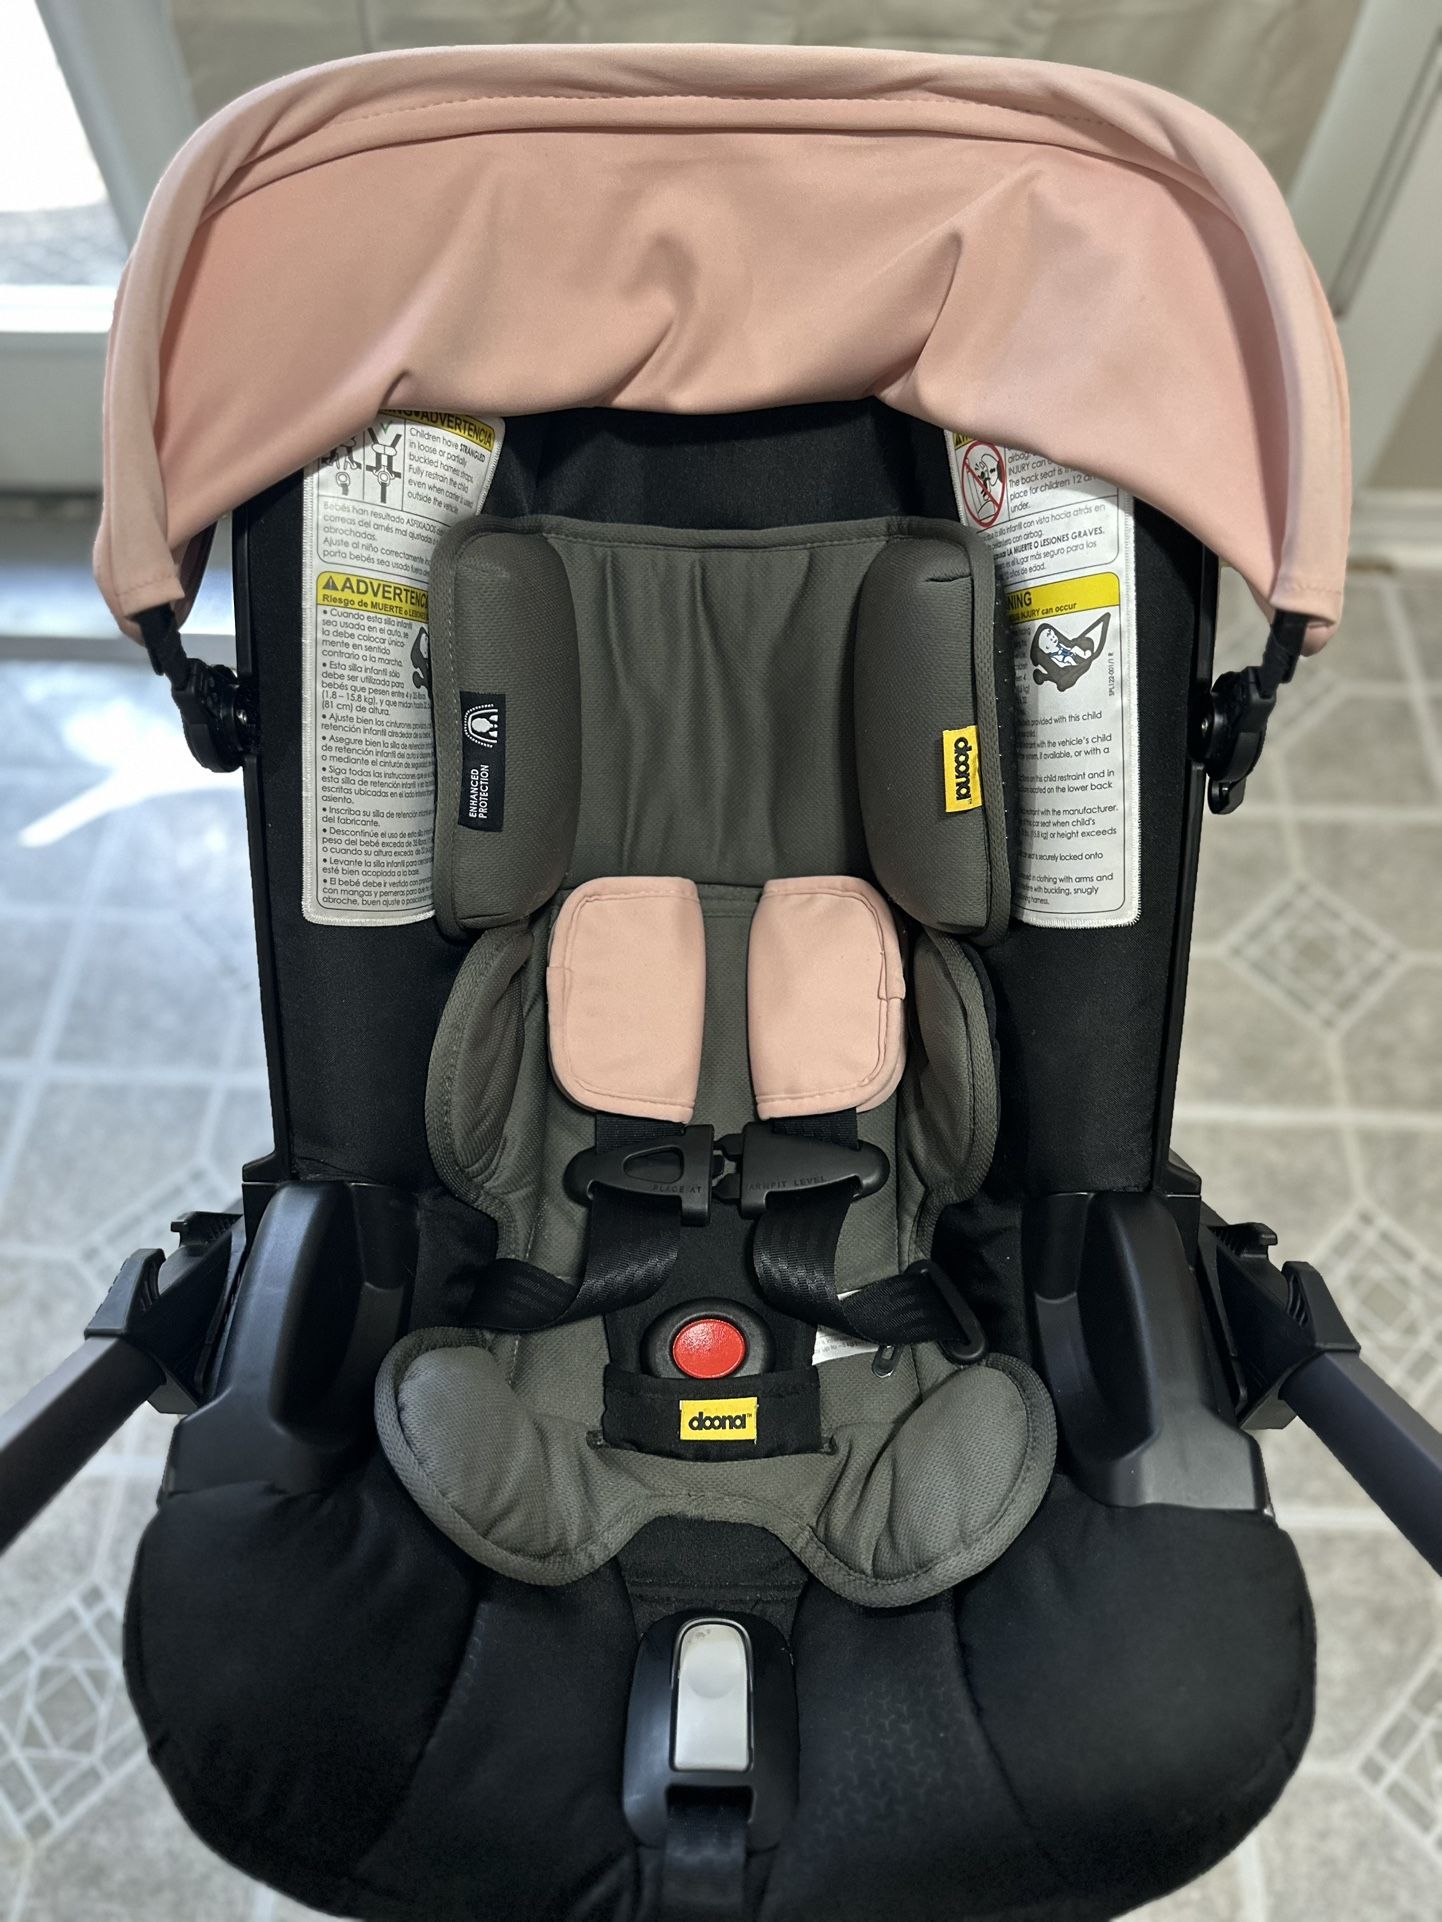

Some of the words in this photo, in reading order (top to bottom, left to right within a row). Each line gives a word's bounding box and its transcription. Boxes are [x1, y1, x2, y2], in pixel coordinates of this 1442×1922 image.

[420, 412, 491, 447] ADVERTENCIA
[410, 428, 440, 442] Children
[442, 438, 458, 449] have
[460, 444, 485, 462] STRANGLED
[418, 442, 436, 454] loose
[409, 453, 438, 467] buckled
[409, 465, 424, 476] Fully
[426, 471, 448, 482] restrain
[1008, 462, 1030, 476] INJURY
[1032, 459, 1046, 469] can
[1009, 479, 1019, 488] The
[1021, 473, 1039, 485] back
[1040, 469, 1056, 478] seat
[408, 479, 426, 488] even
[428, 485, 445, 494] when
[1010, 489, 1028, 500] place
[1030, 486, 1038, 495] for
[1040, 479, 1070, 492] children
[1073, 475, 1082, 484] 12
[408, 491, 431, 504] outside
[433, 497, 442, 507] the
[1011, 501, 1031, 513] under.
[324, 503, 350, 512] Bebés
[352, 506, 369, 515] han
[371, 510, 404, 524] resultado
[1036, 517, 1049, 525] vista
[1051, 510, 1071, 520] hacia
[1073, 507, 1092, 516] atrás
[324, 514, 356, 525] correas
[358, 519, 371, 527] del
[373, 522, 393, 533] arnés
[395, 528, 407, 536] mal
[1014, 542, 1032, 555] MUERTE
[1041, 533, 1069, 547] LESIONES
[1071, 526, 1104, 540] GRAVES.
[324, 537, 349, 547] Ajuste
[361, 542, 378, 552] niño
[381, 547, 424, 563] correctamente
[1043, 547, 1064, 558] seguro
[1066, 543, 1084, 555] para
[1086, 541, 1096, 549] los
[323, 549, 347, 558] porta
[349, 552, 375, 563] bebés
[376, 558, 390, 567] sea
[392, 562, 410, 572] usado
[1029, 563, 1045, 573] edad.
[322, 594, 355, 606] Riesgo
[358, 598, 368, 607] de
[371, 602, 403, 615] MUERTE
[1008, 591, 1032, 610] NING
[1055, 602, 1077, 612] occur
[330, 608, 365, 620] Cuando
[367, 616, 382, 624] esta
[322, 619, 337, 627] sea
[340, 620, 365, 631] usada
[332, 629, 355, 639] debe
[357, 634, 386, 644] colocar
[322, 639, 350, 648] mente
[352, 642, 362, 650] en
[365, 644, 390, 655] sentido
[322, 649, 360, 660] contrario
[330, 660, 346, 670] Esta
[349, 663, 362, 672] silla
[364, 666, 387, 677] infantil
[322, 671, 345, 680] debe
[347, 673, 358, 681] ser
[361, 675, 389, 686] utilizada
[322, 681, 348, 691] bebés
[350, 685, 366, 693] que
[368, 686, 389, 696] pesen
[322, 700, 333, 709] (81
[337, 703, 353, 712] cm)
[329, 713, 354, 723] Ajuste
[357, 716, 373, 724] bien
[1068, 714, 1080, 722] this
[1082, 711, 1102, 720] child
[322, 723, 361, 733] retención
[363, 727, 386, 737] infantil
[329, 735, 363, 745] Asegure
[365, 738, 381, 747] bien
[1058, 736, 1089, 746] vehicle's
[1091, 734, 1111, 743] child
[335, 745, 373, 756] retención
[375, 749, 396, 758] infantil
[1084, 748, 1101, 756] with
[329, 756, 369, 765] mediante
[329, 766, 346, 775] Siga
[349, 767, 371, 777] todas
[373, 770, 382, 778] las
[954, 737, 972, 800] doona
[1057, 772, 1086, 781] restraint
[1088, 770, 1104, 778] and
[341, 777, 355, 785] silla
[370, 779, 400, 788] retención
[1068, 784, 1088, 792] lower
[1090, 781, 1112, 790] back
[322, 785, 352, 794] escritas
[354, 786, 388, 796] ubicadas
[469, 769, 478, 817] ENHANCED
[478, 765, 489, 818] PROTECTION
[322, 794, 354, 804] asiento.
[329, 806, 360, 816] Inscriba
[1063, 805, 1118, 815] manufacturer.
[337, 816, 380, 827] fabricante.
[1072, 818, 1095, 827] child's
[330, 827, 378, 838] Descontinúe
[1057, 830, 1079, 839] height
[1081, 827, 1117, 837] exceeds
[359, 839, 380, 847] bebé
[381, 839, 404, 848] exceda
[330, 847, 362, 856] cuando
[374, 849, 392, 857] altura
[1060, 852, 1083, 860] locked
[330, 857, 362, 867] Levante
[373, 859, 384, 868] silla
[342, 868, 359, 876] bien
[362, 868, 395, 878] acoplada
[1096, 873, 1113, 881] and
[338, 878, 360, 886] bebé
[362, 880, 382, 888] debe
[341, 887, 372, 898] mangas
[1073, 886, 1098, 894] snugly
[322, 895, 359, 905] abroche,
[362, 898, 380, 906] buen
[382, 898, 400, 907] ajuste
[794, 1176, 826, 1186] LEVEL
[688, 1412, 746, 1431] doona
